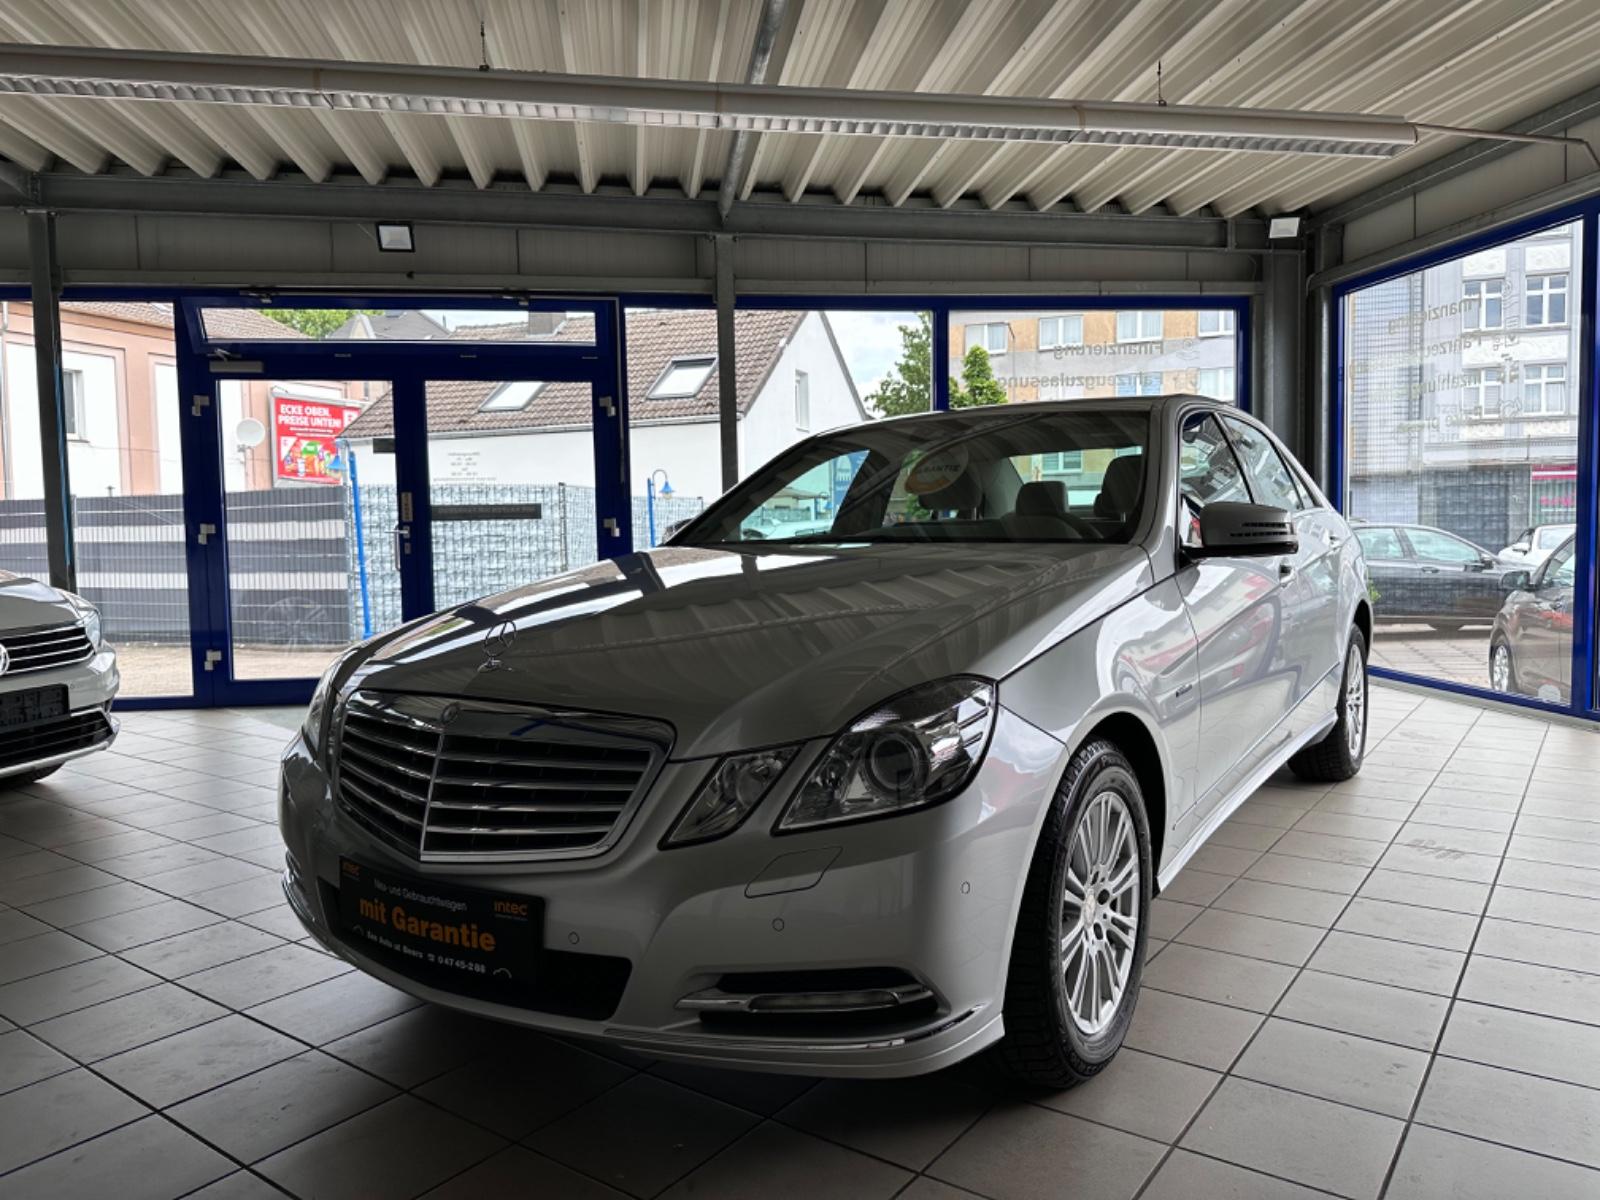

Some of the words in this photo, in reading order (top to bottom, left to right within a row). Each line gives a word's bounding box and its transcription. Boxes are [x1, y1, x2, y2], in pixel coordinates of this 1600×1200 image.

[280, 404, 303, 415] ECKE
[278, 415, 309, 427] PREISE
[310, 417, 342, 428] UNTEN!
[359, 897, 387, 925] mit
[391, 906, 496, 952] Garantie
